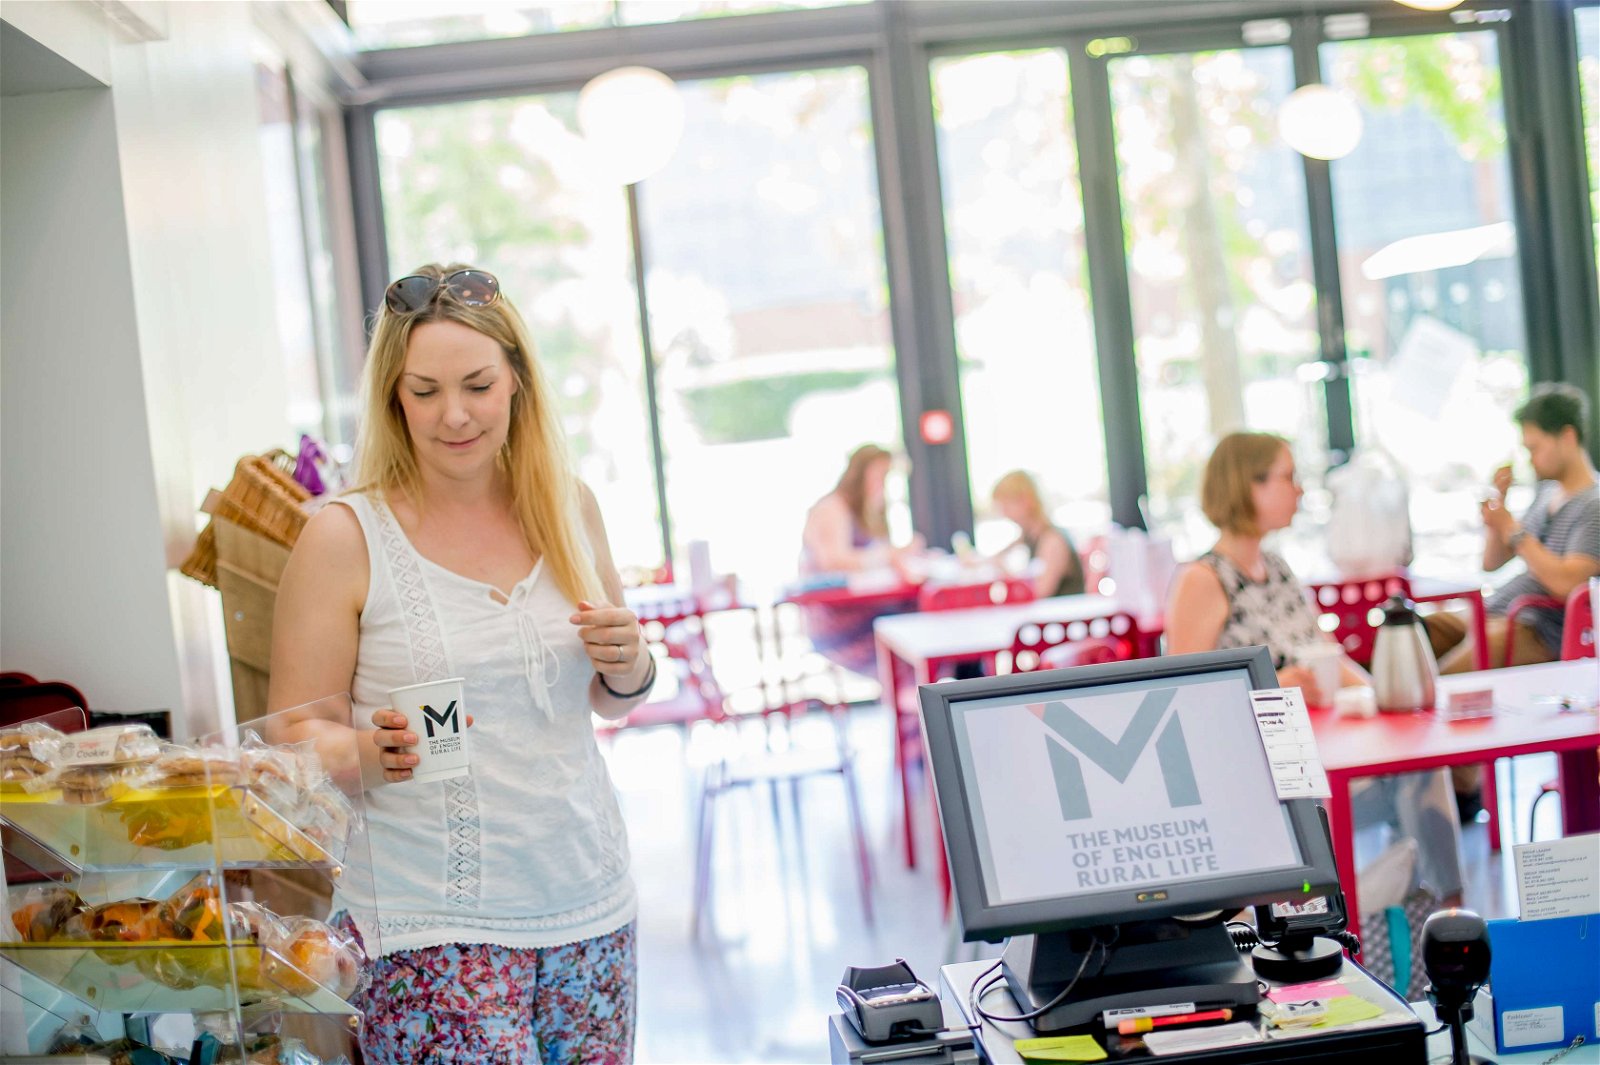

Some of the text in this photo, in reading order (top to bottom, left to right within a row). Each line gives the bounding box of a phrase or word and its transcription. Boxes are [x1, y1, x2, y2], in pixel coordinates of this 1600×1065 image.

[1066, 817, 1209, 850] THE MUSEUM
[1072, 836, 1214, 869] OF ENGLISH
[1076, 854, 1220, 888] RURAL LIFE
